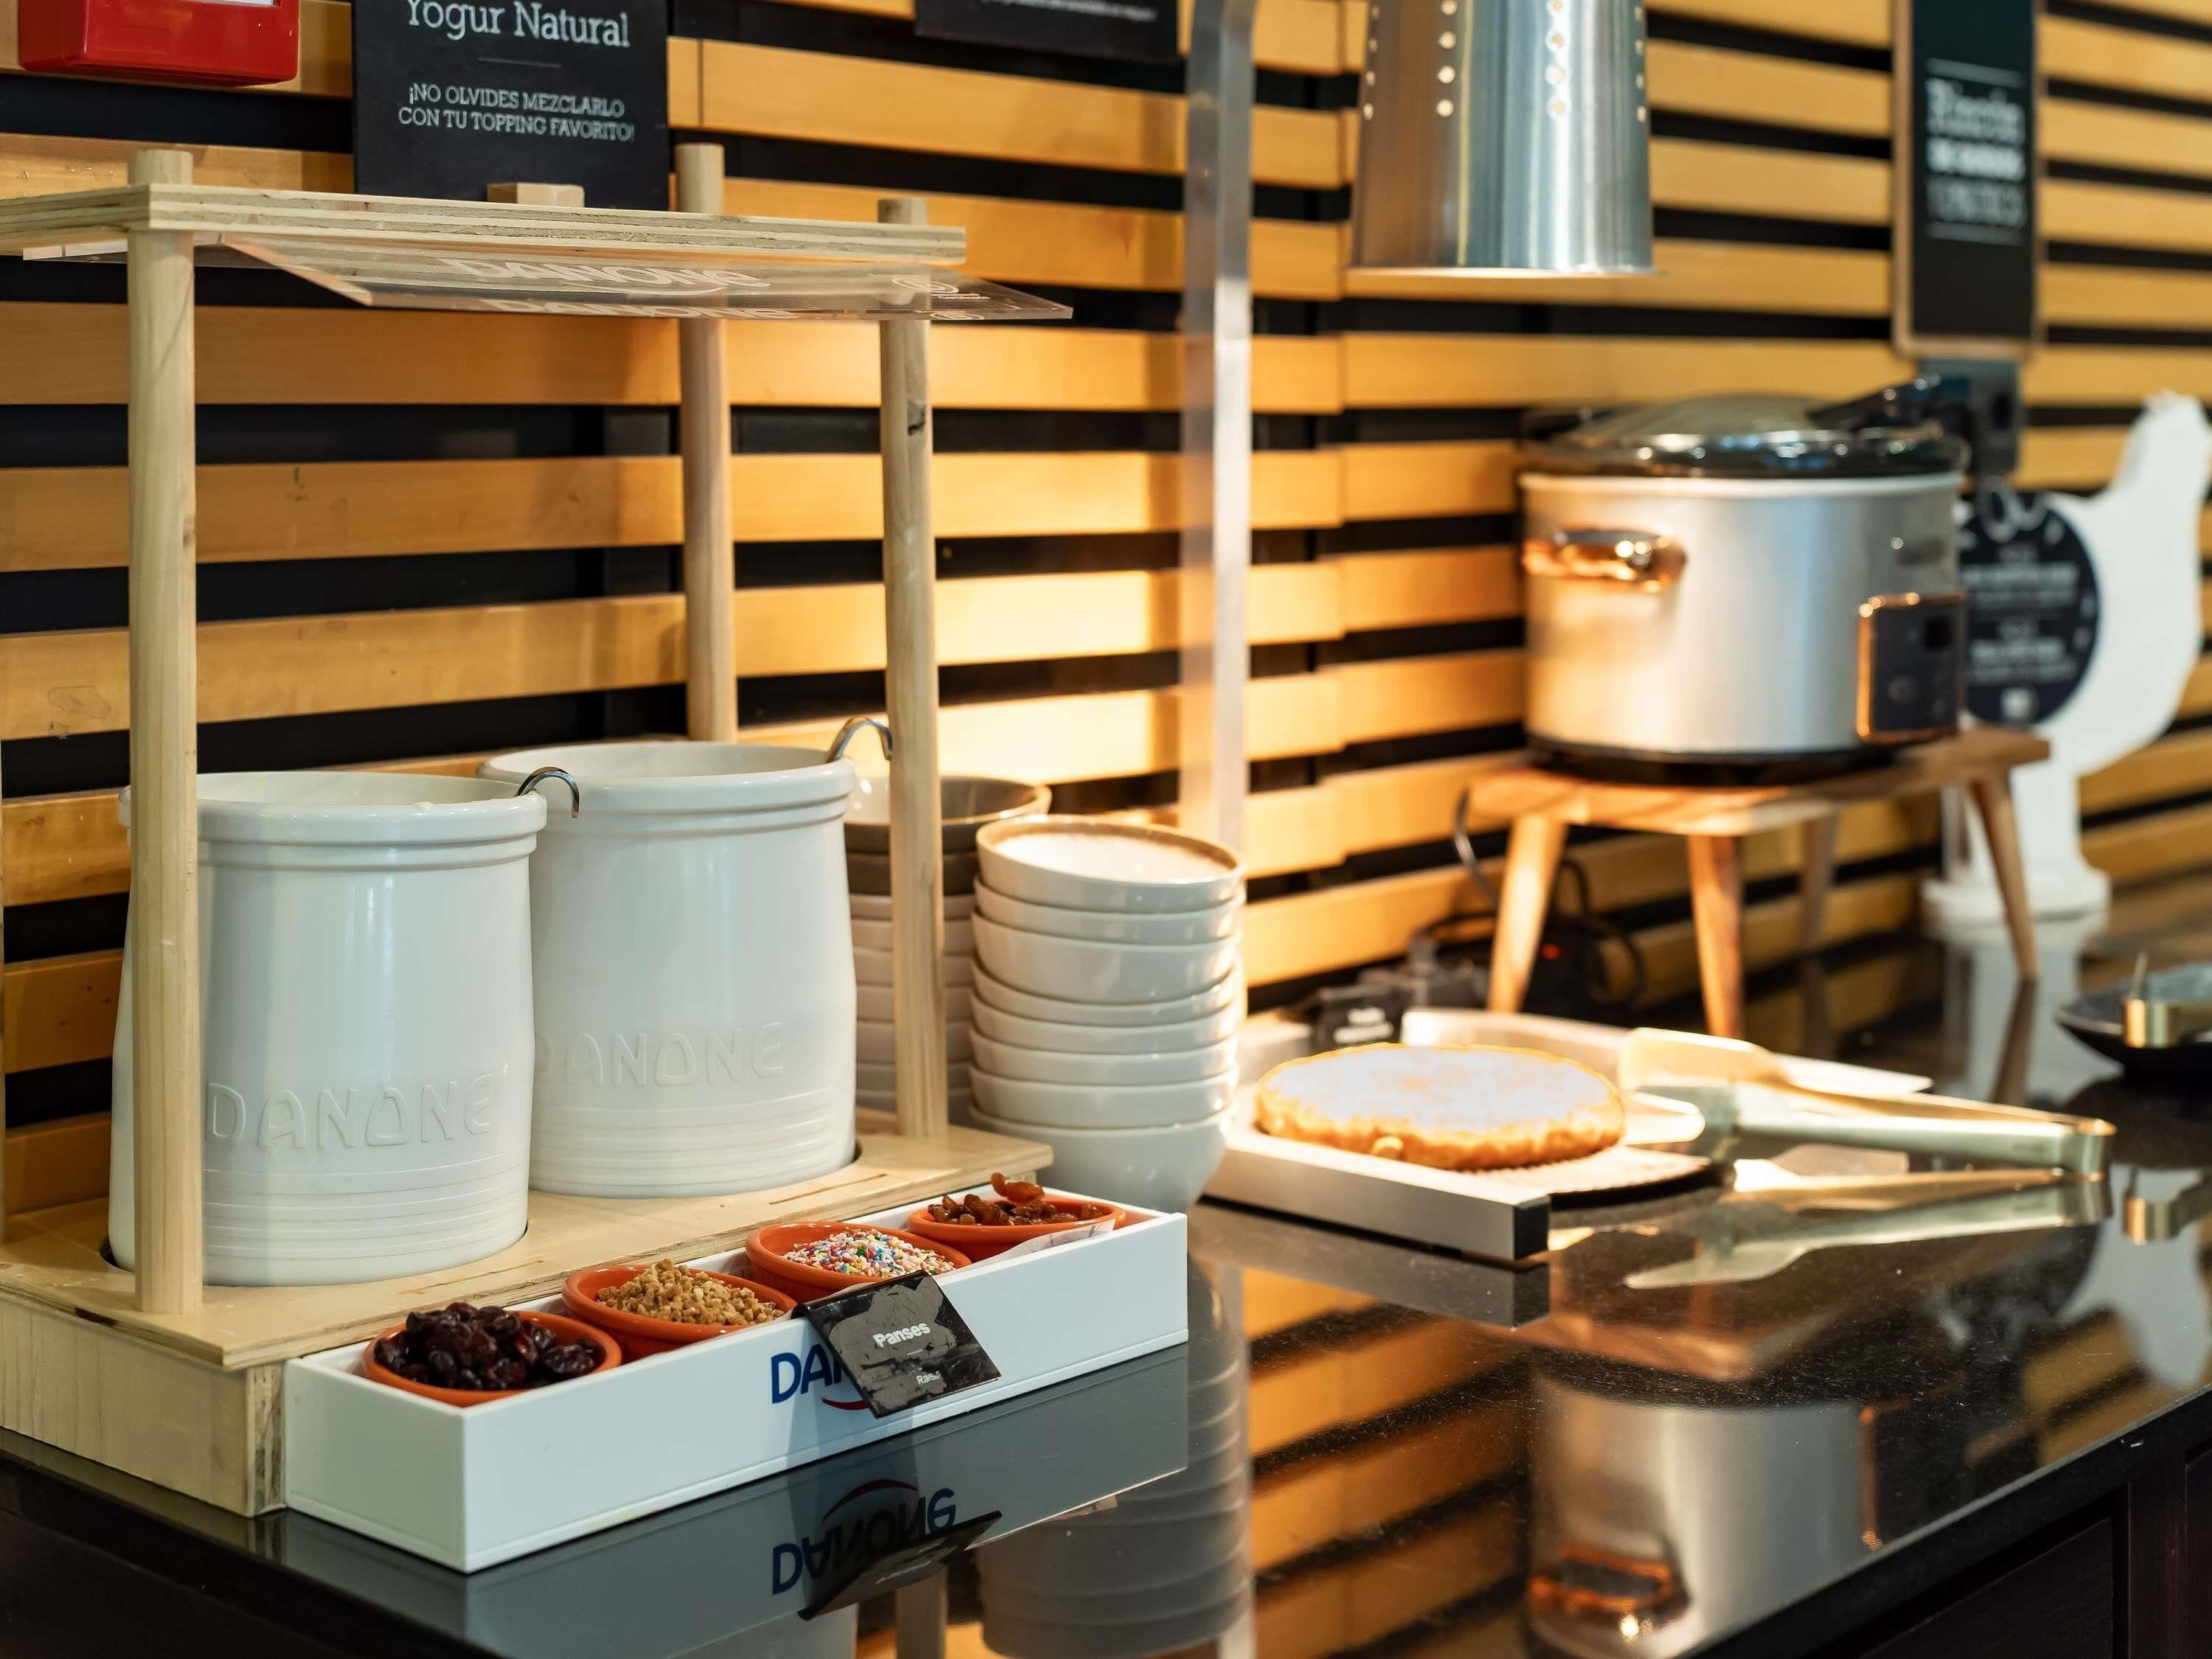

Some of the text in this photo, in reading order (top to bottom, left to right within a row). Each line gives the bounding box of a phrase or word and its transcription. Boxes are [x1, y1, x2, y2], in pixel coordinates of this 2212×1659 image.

[408, 0, 630, 47] Yogur Natural
[408, 83, 625, 118] ¡NO OLVIDES MEZCLARLO
[398, 106, 440, 126] CON
[443, 109, 467, 129] TU
[470, 112, 547, 135] TOPPING
[205, 1073, 493, 1150] DANONE
[872, 1323, 931, 1348] Panses
